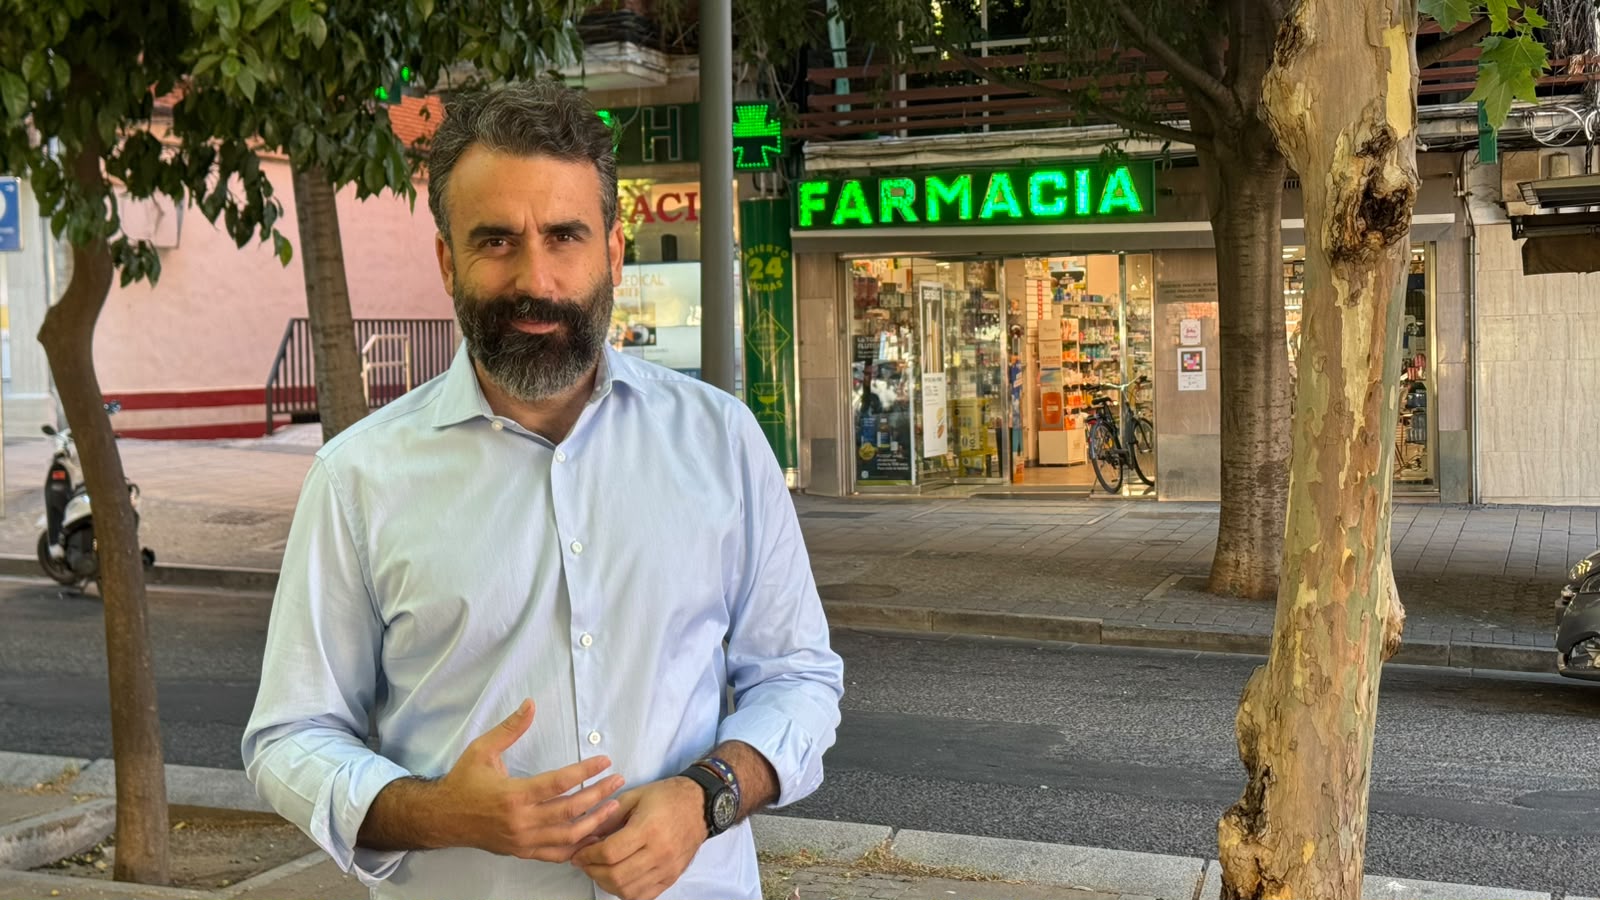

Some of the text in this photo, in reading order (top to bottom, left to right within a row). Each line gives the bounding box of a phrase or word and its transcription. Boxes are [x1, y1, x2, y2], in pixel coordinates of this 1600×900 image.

[799, 166, 1143, 226] FARMACIA
[617, 191, 699, 224] ACI
[749, 257, 784, 279] 24
[622, 272, 664, 287] EDICAL
[750, 280, 783, 291] HORAS
